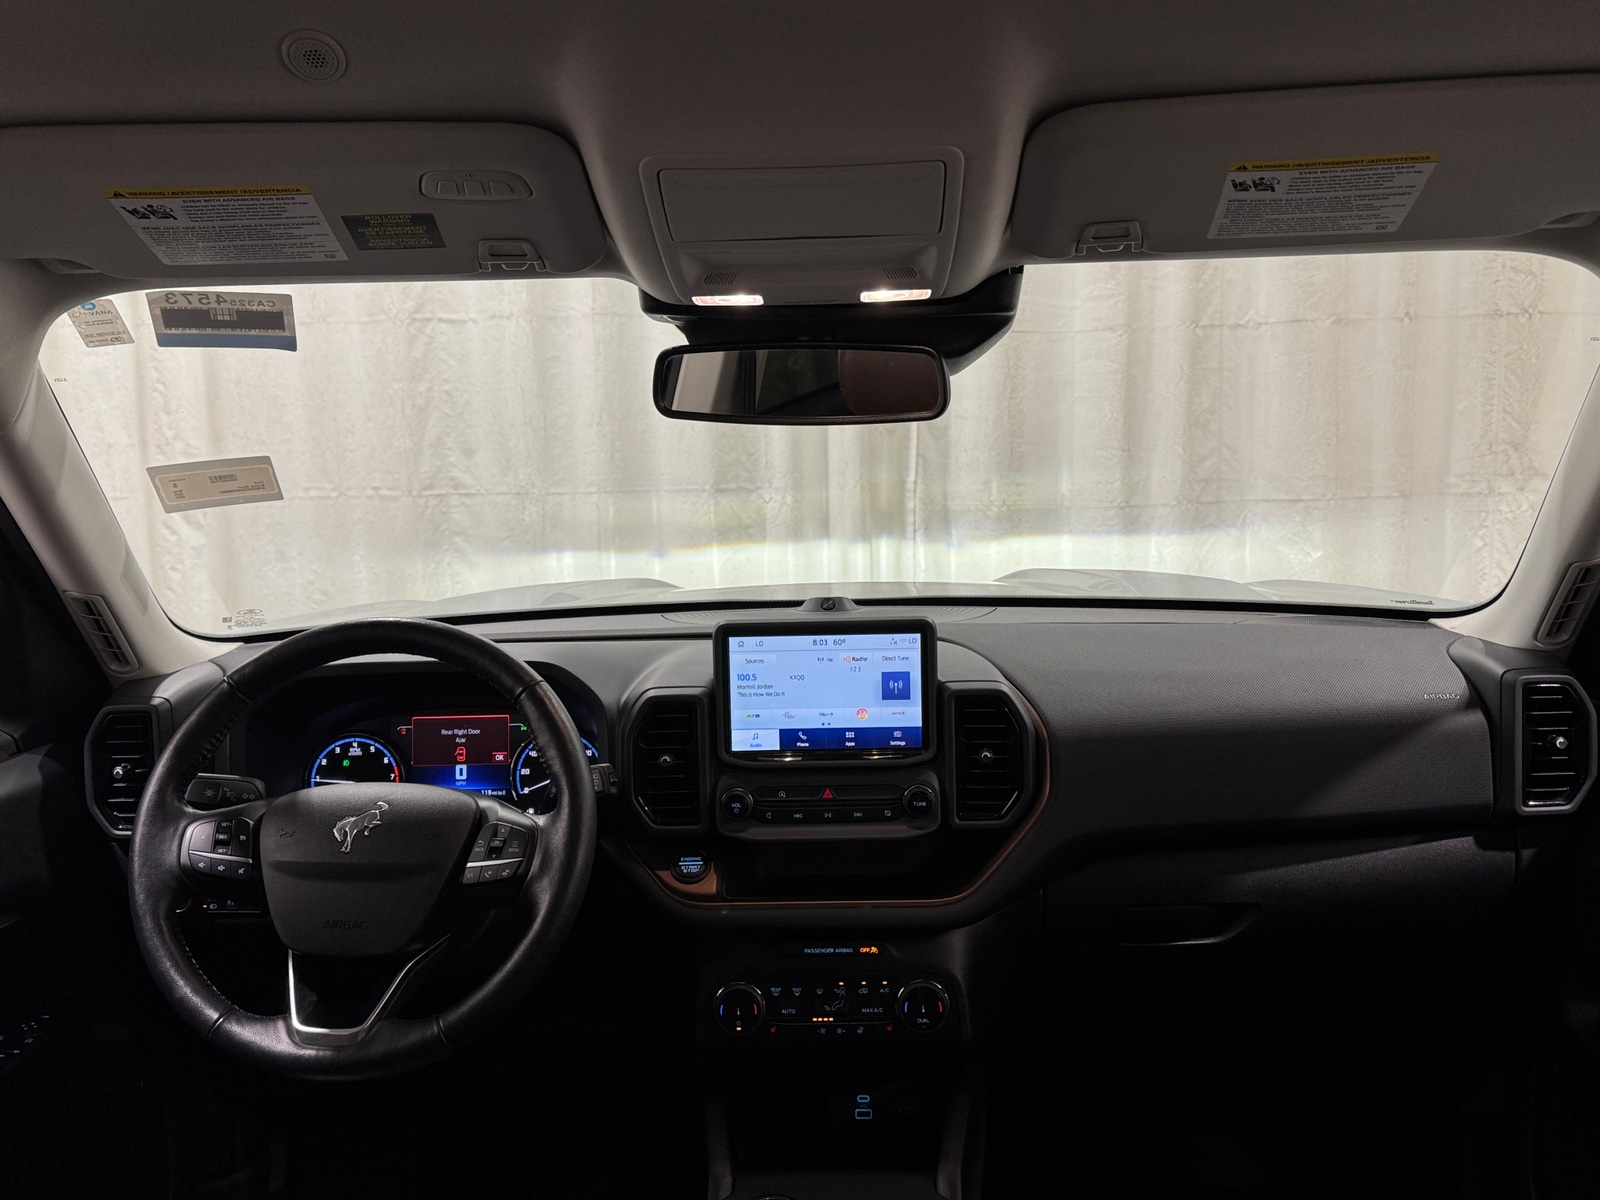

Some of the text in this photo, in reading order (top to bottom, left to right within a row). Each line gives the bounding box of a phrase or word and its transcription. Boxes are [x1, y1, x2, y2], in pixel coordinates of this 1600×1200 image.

[755, 640, 764, 648] LO
[812, 639, 828, 647] 8:03
[908, 637, 918, 645] LO
[736, 673, 757, 681] 100.5
[454, 729, 468, 737] Right
[455, 736, 467, 744] Ajar
[335, 746, 341, 754] 3
[370, 745, 376, 753] 5
[320, 758, 327, 766] 2
[383, 756, 389, 764] 6
[455, 764, 468, 781] 0
[520, 768, 531, 776] 20
[323, 919, 368, 930] AIRBAG
